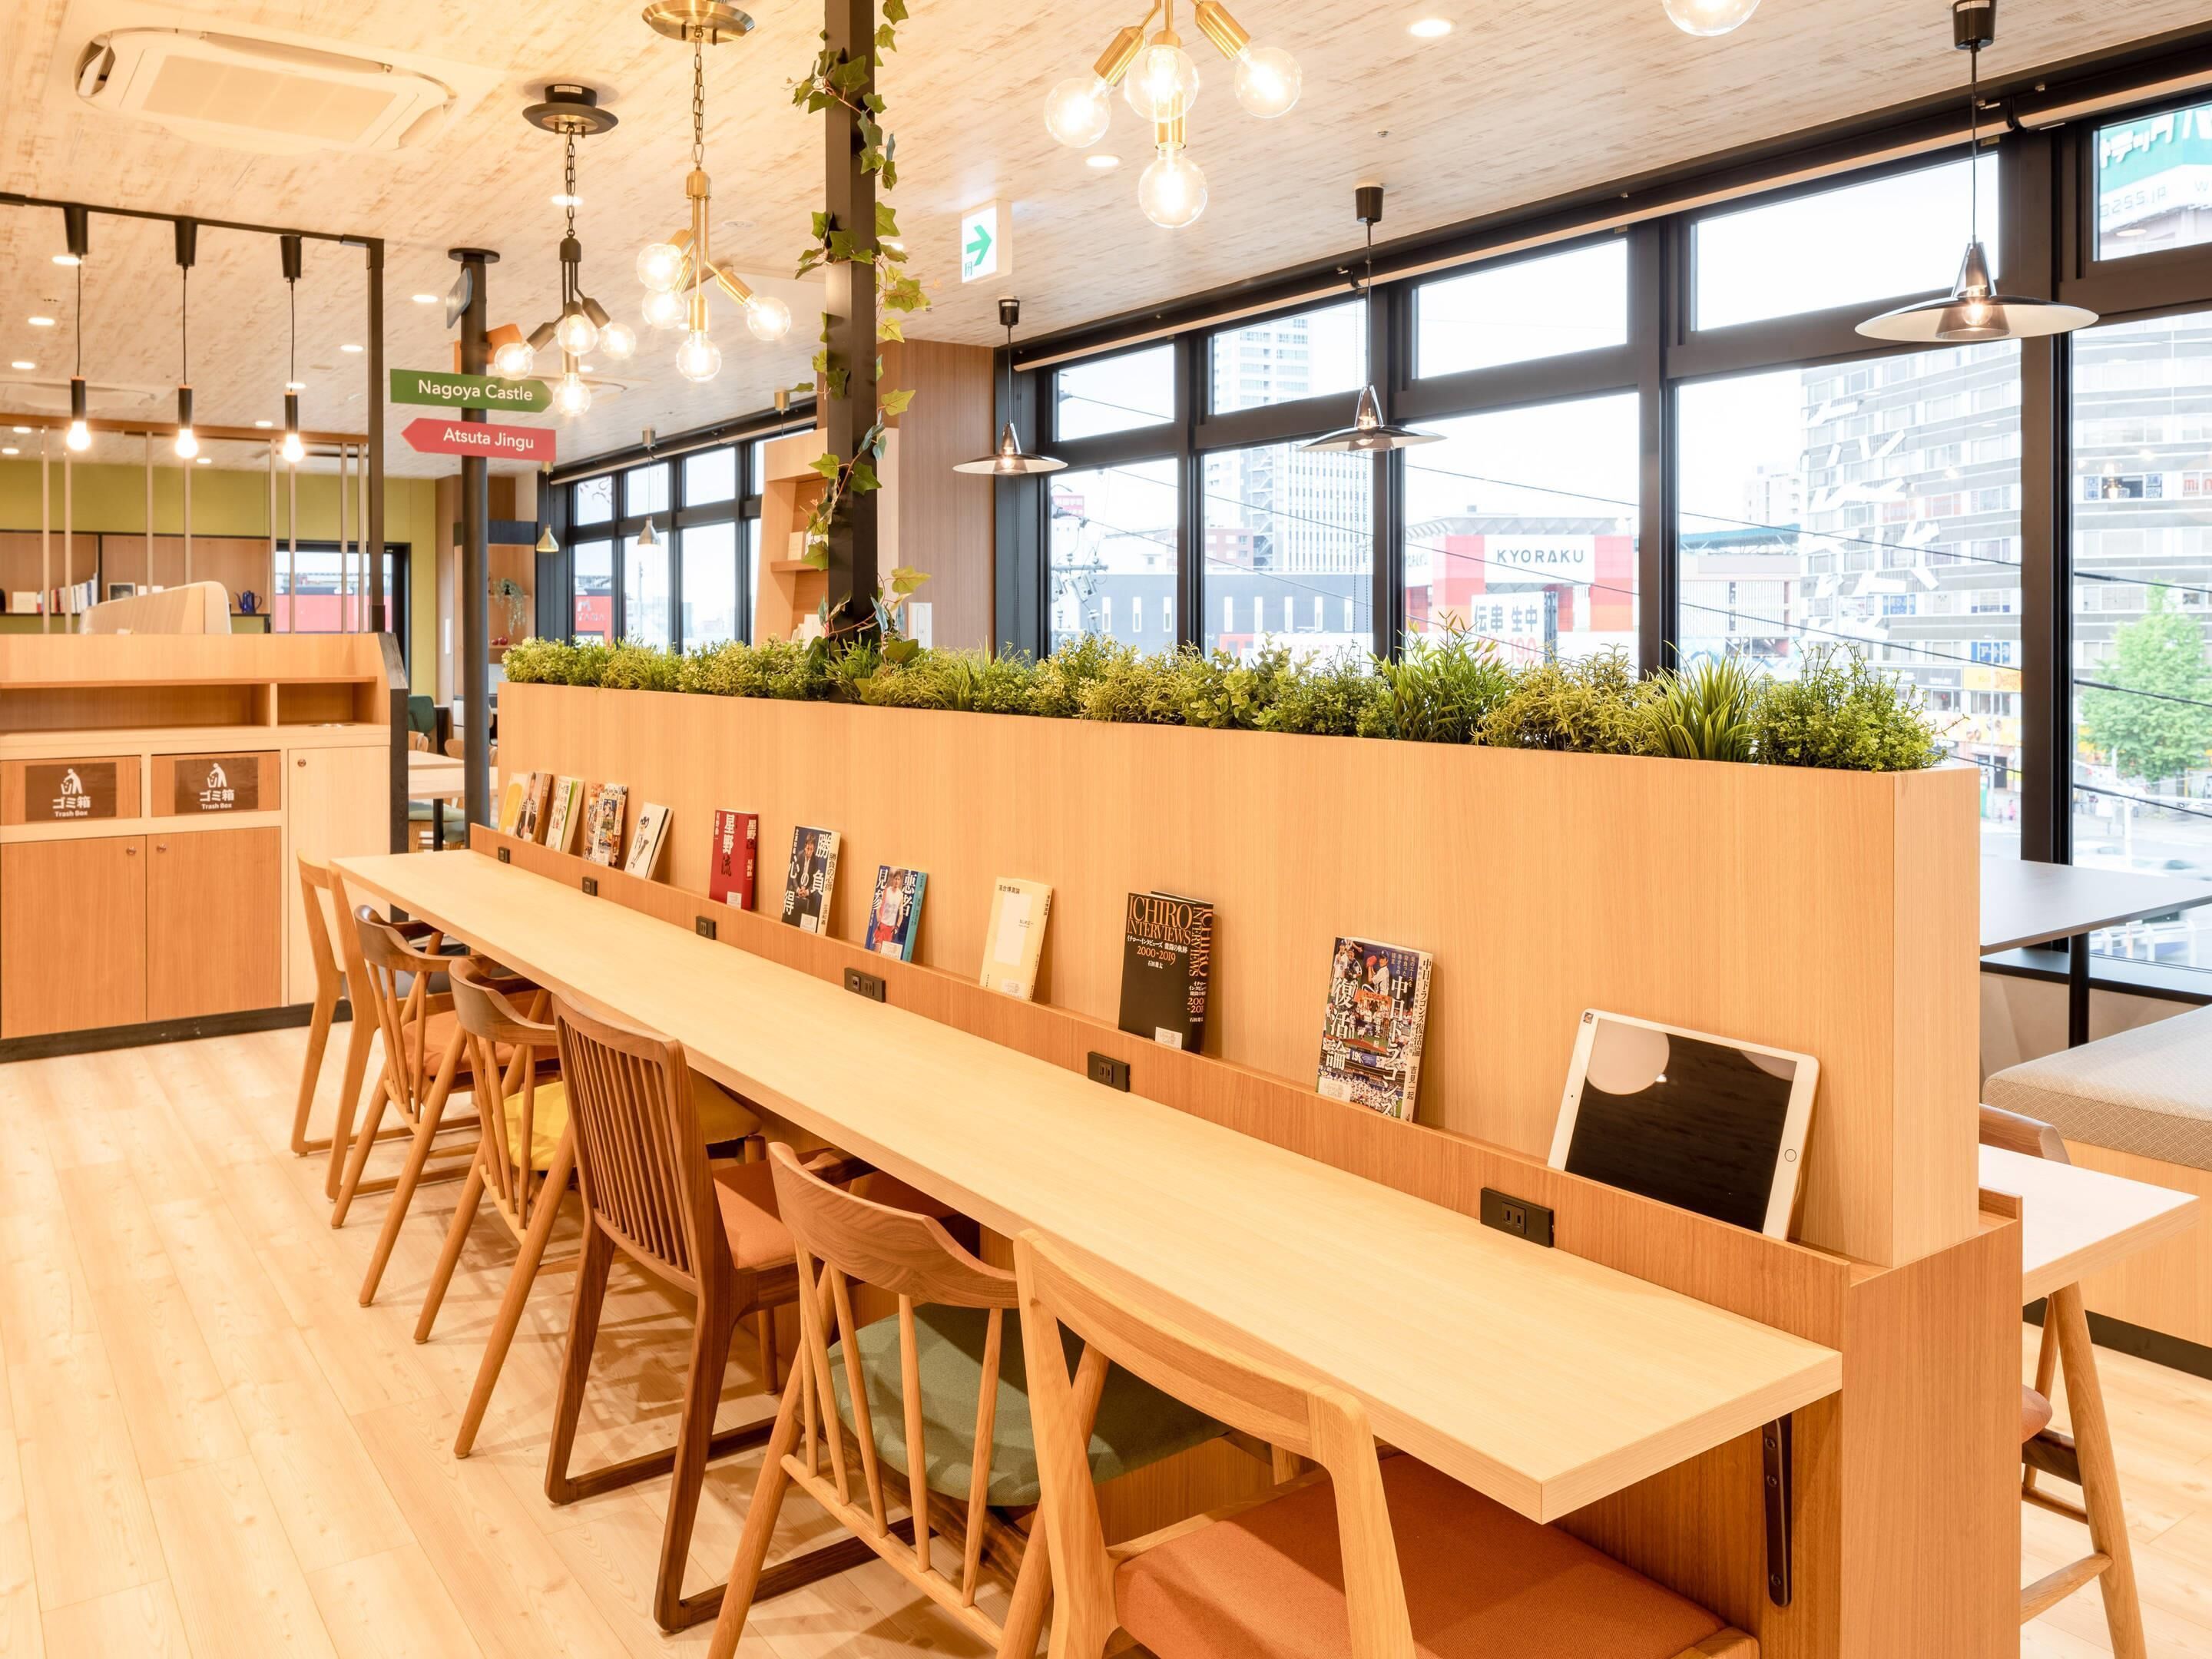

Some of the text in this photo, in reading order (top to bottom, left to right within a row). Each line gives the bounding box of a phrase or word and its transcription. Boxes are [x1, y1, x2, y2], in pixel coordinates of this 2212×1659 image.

[418, 379, 533, 401] Nagoya Castle
[443, 427, 535, 452] Atsuta Jingu
[1497, 549, 1584, 563] KYORAKU
[1474, 604, 1538, 634] 伝串 生中
[52, 796, 91, 809] ゴミ箱
[200, 789, 234, 803] ゴミ箱
[720, 814, 735, 876] 星野流
[824, 853, 837, 892] 勝負の心得
[1128, 896, 1193, 930] ICHIRO
[1127, 919, 1191, 945] INTERVIEWS
[1188, 906, 1205, 977] INTERVIEWS
[1197, 906, 1214, 978] ICHIRO
[1137, 945, 1177, 965] 2000-2019
[1187, 997, 1205, 1005] 200
[1323, 978, 1358, 1071] 復活論
[1381, 975, 1409, 1118] 中日ドラゴンズ
[1406, 1065, 1418, 1101] 吉見一起
